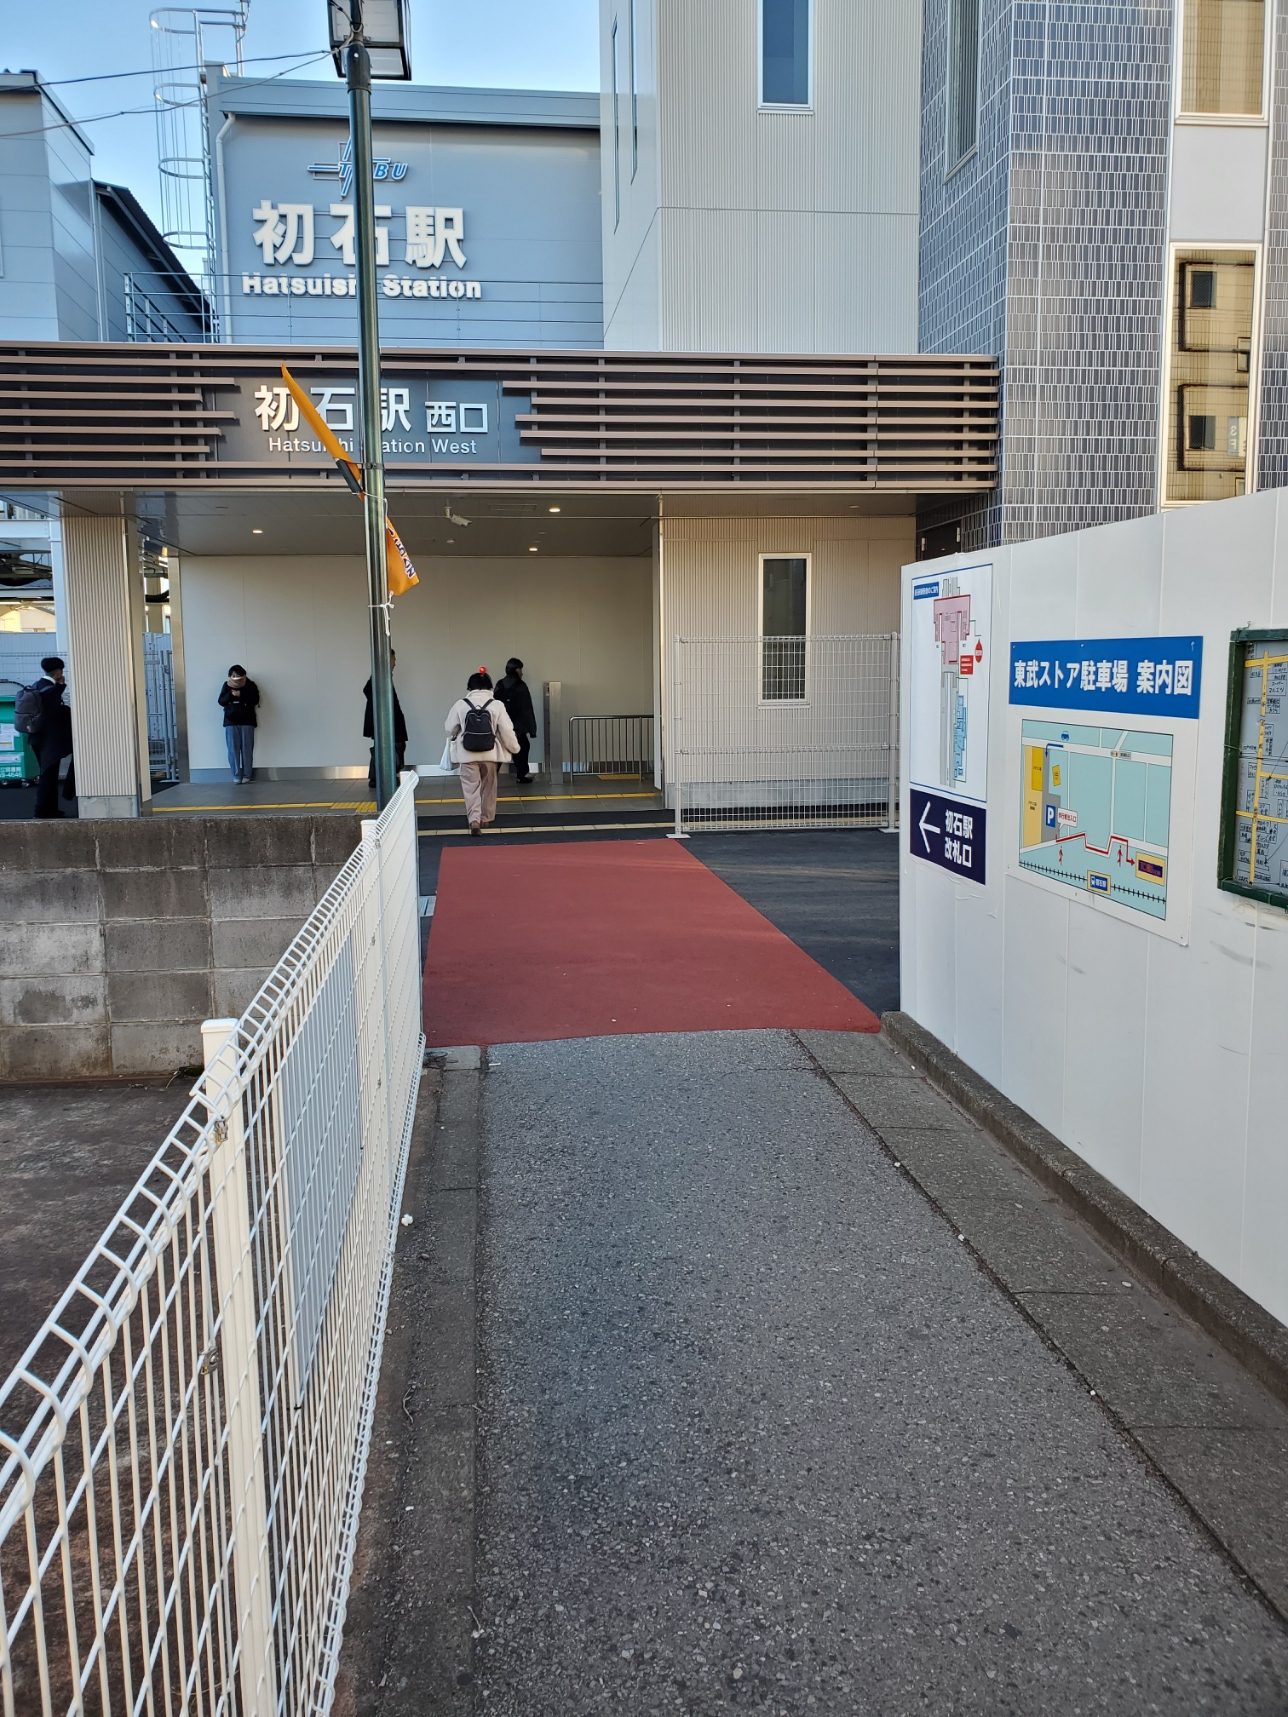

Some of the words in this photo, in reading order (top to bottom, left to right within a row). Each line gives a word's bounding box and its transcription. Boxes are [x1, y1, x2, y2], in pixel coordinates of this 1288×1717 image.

[338, 162, 408, 181] TBU
[253, 200, 467, 269] 初石駅
[382, 274, 482, 299] Station
[425, 401, 488, 434] 西口
[382, 438, 425, 453] ation
[432, 438, 477, 454] West
[1013, 659, 1129, 693] 東武ストア駐車場
[1136, 659, 1194, 696] 案内図
[945, 808, 974, 841] 初石駅
[944, 837, 972, 868] 改札口
